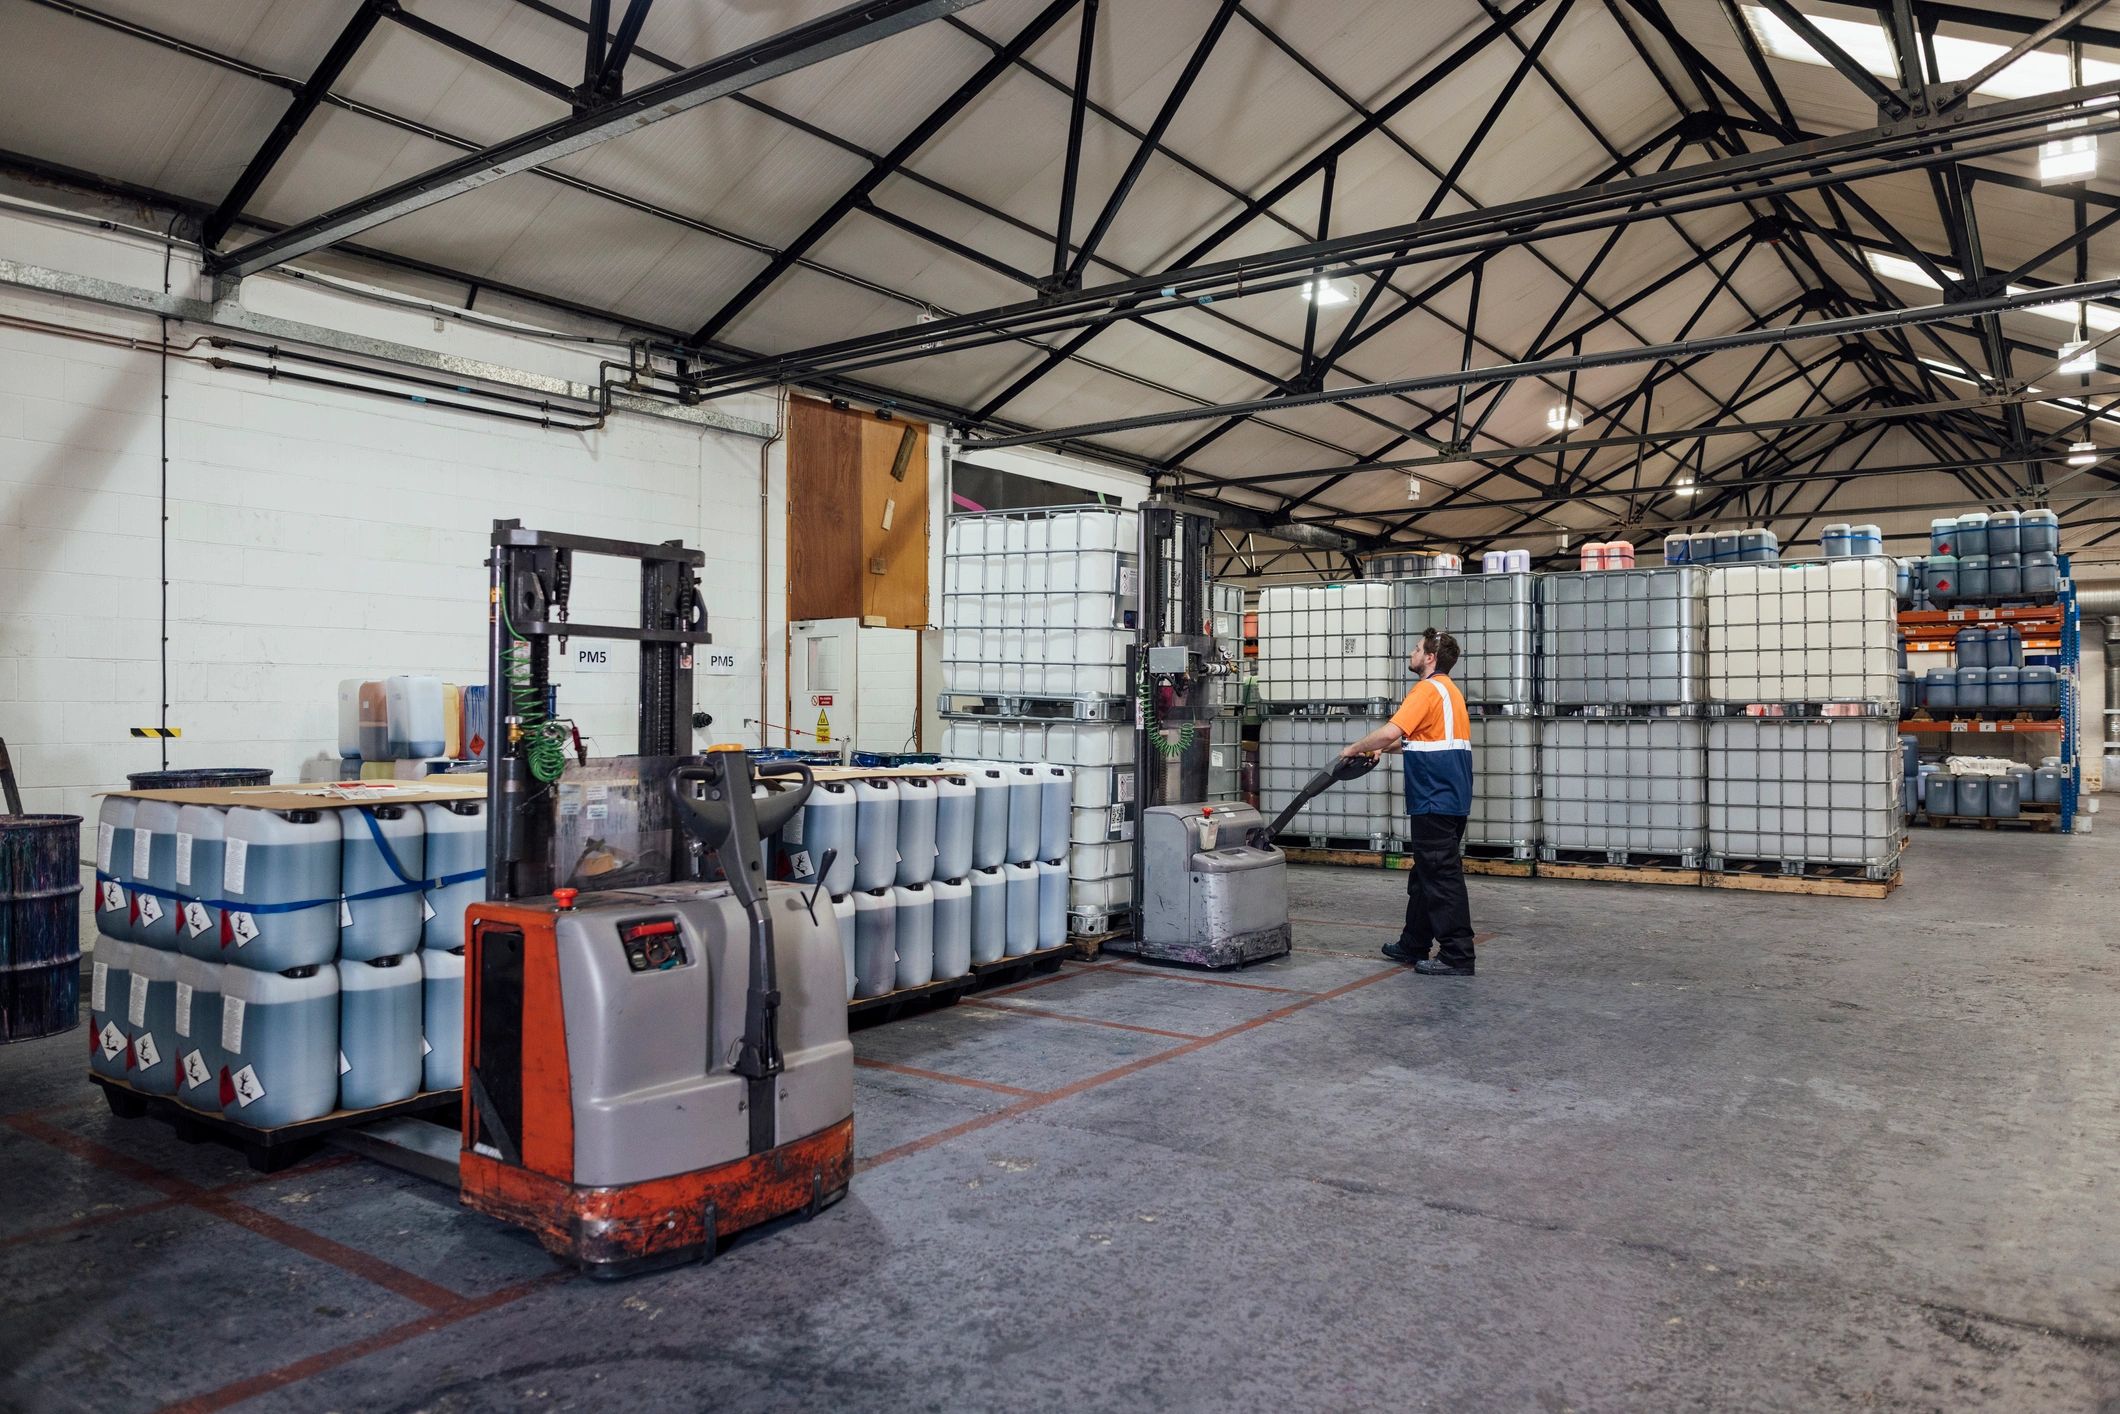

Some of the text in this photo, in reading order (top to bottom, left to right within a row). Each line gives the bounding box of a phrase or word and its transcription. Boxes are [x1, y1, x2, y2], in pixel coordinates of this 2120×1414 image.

[579, 651, 607, 663] PM5
[710, 656, 734, 667] PM5
[2061, 766, 2068, 774] 3
